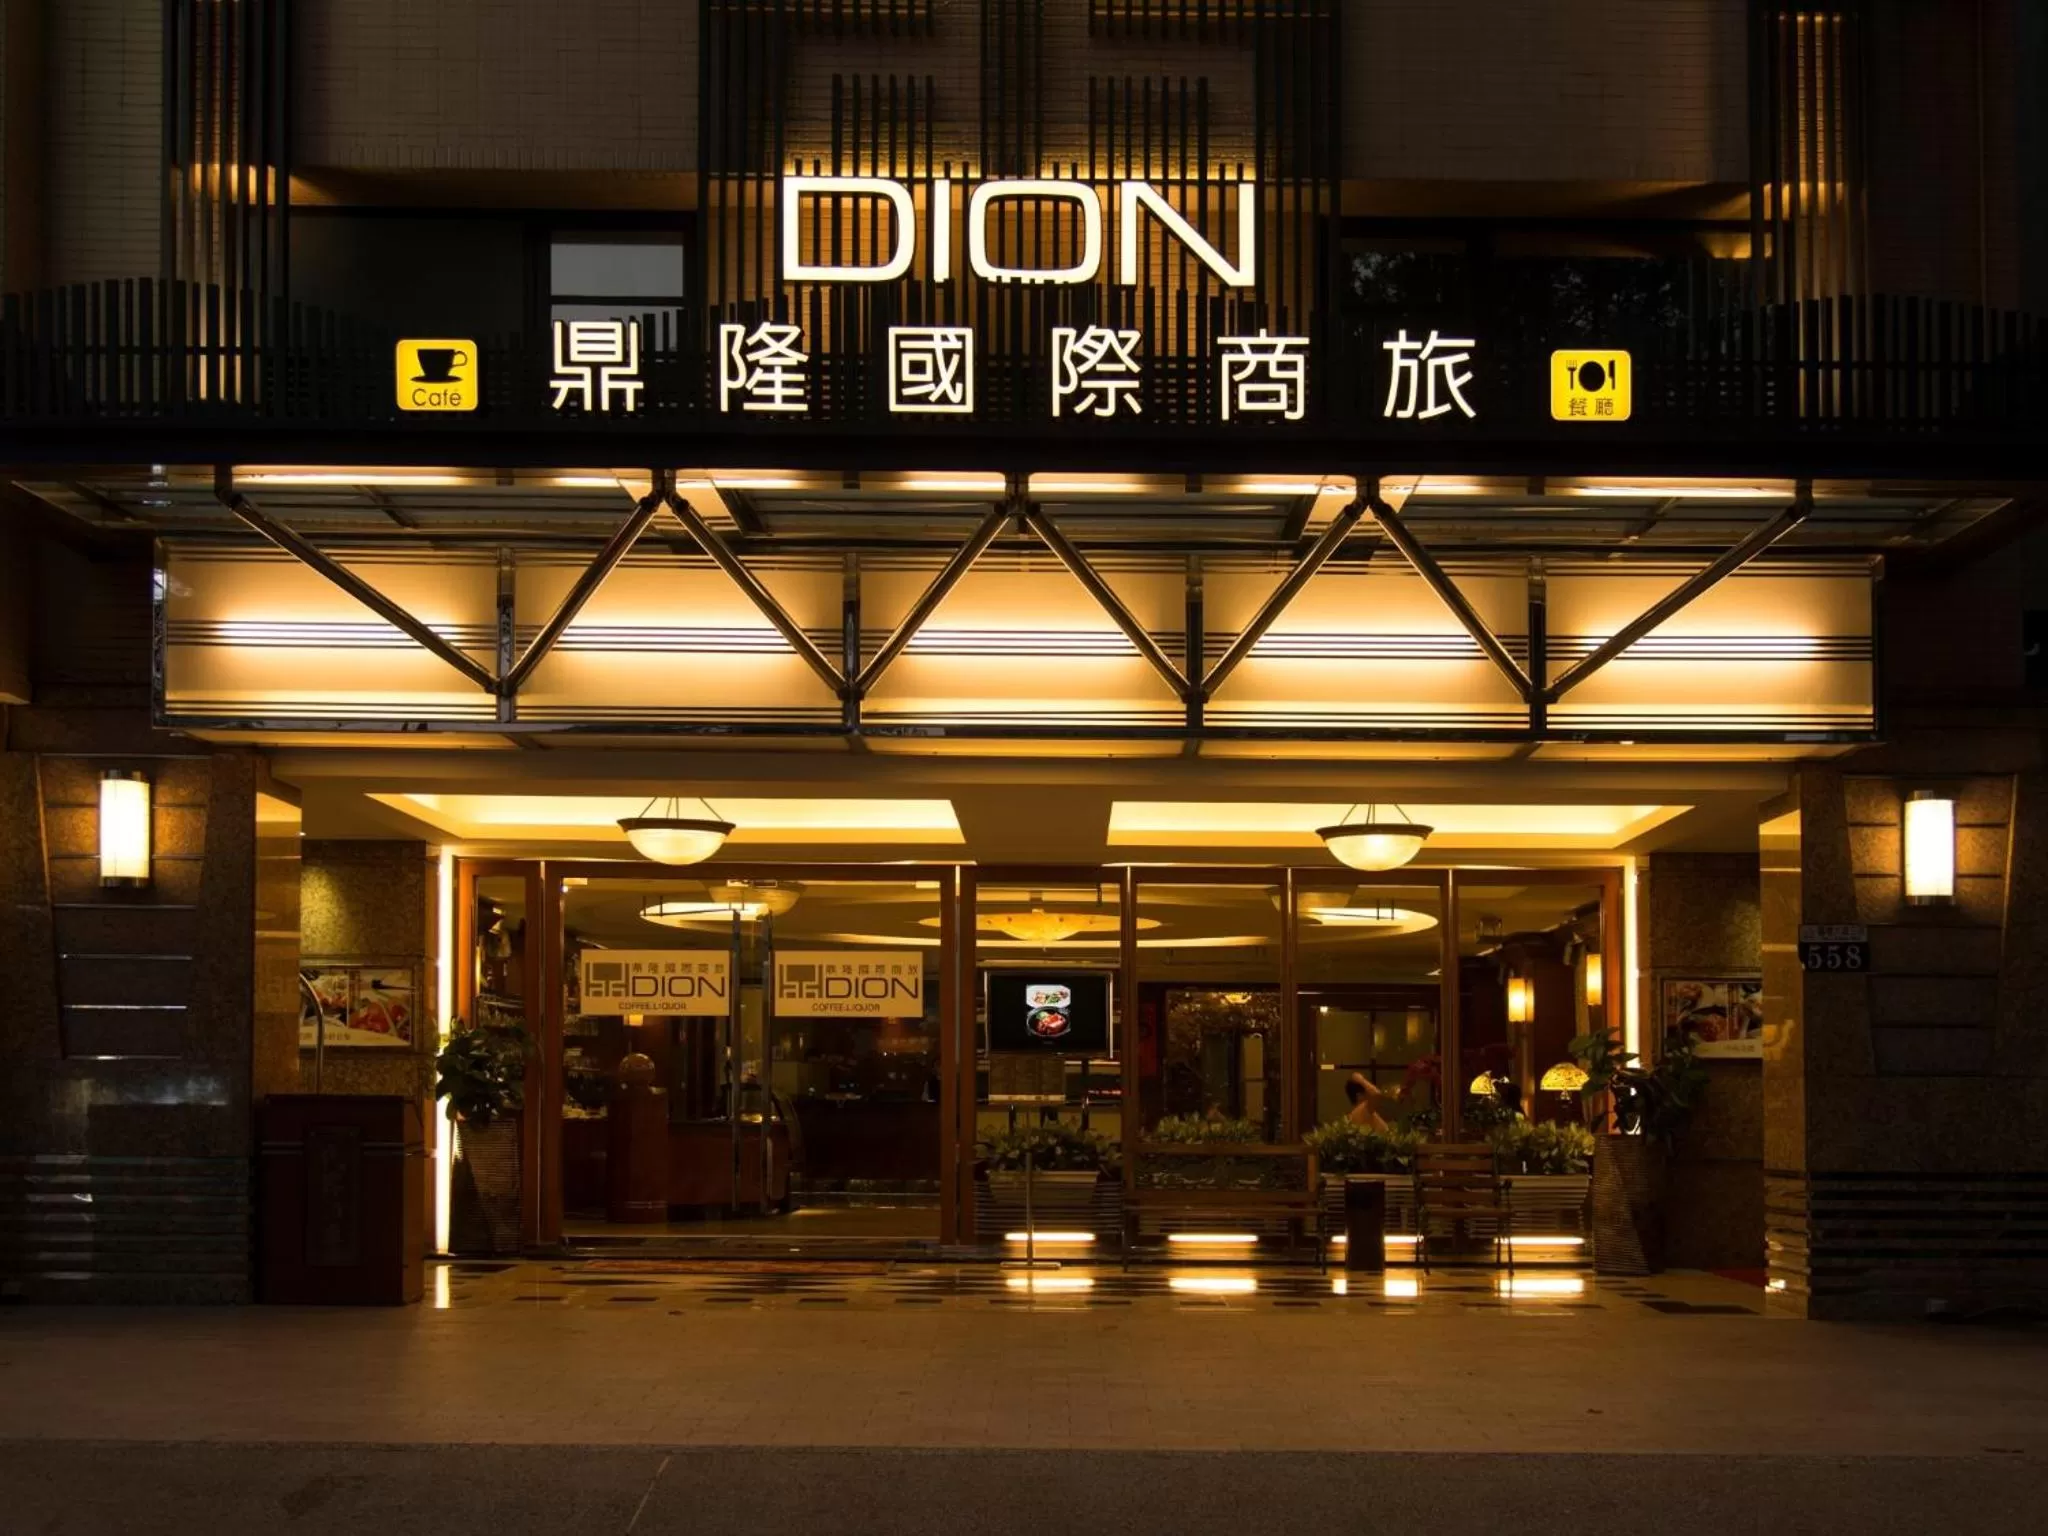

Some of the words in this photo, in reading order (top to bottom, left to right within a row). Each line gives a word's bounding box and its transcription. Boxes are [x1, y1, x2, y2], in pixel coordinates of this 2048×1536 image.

[783, 176, 1255, 287] DION
[550, 321, 1475, 420] 鼎隆國際商旅
[412, 388, 462, 406] Café
[1568, 397, 1614, 417] 餐廳
[1808, 944, 1862, 969] 558
[631, 976, 725, 997] DION
[825, 977, 919, 999] DION
